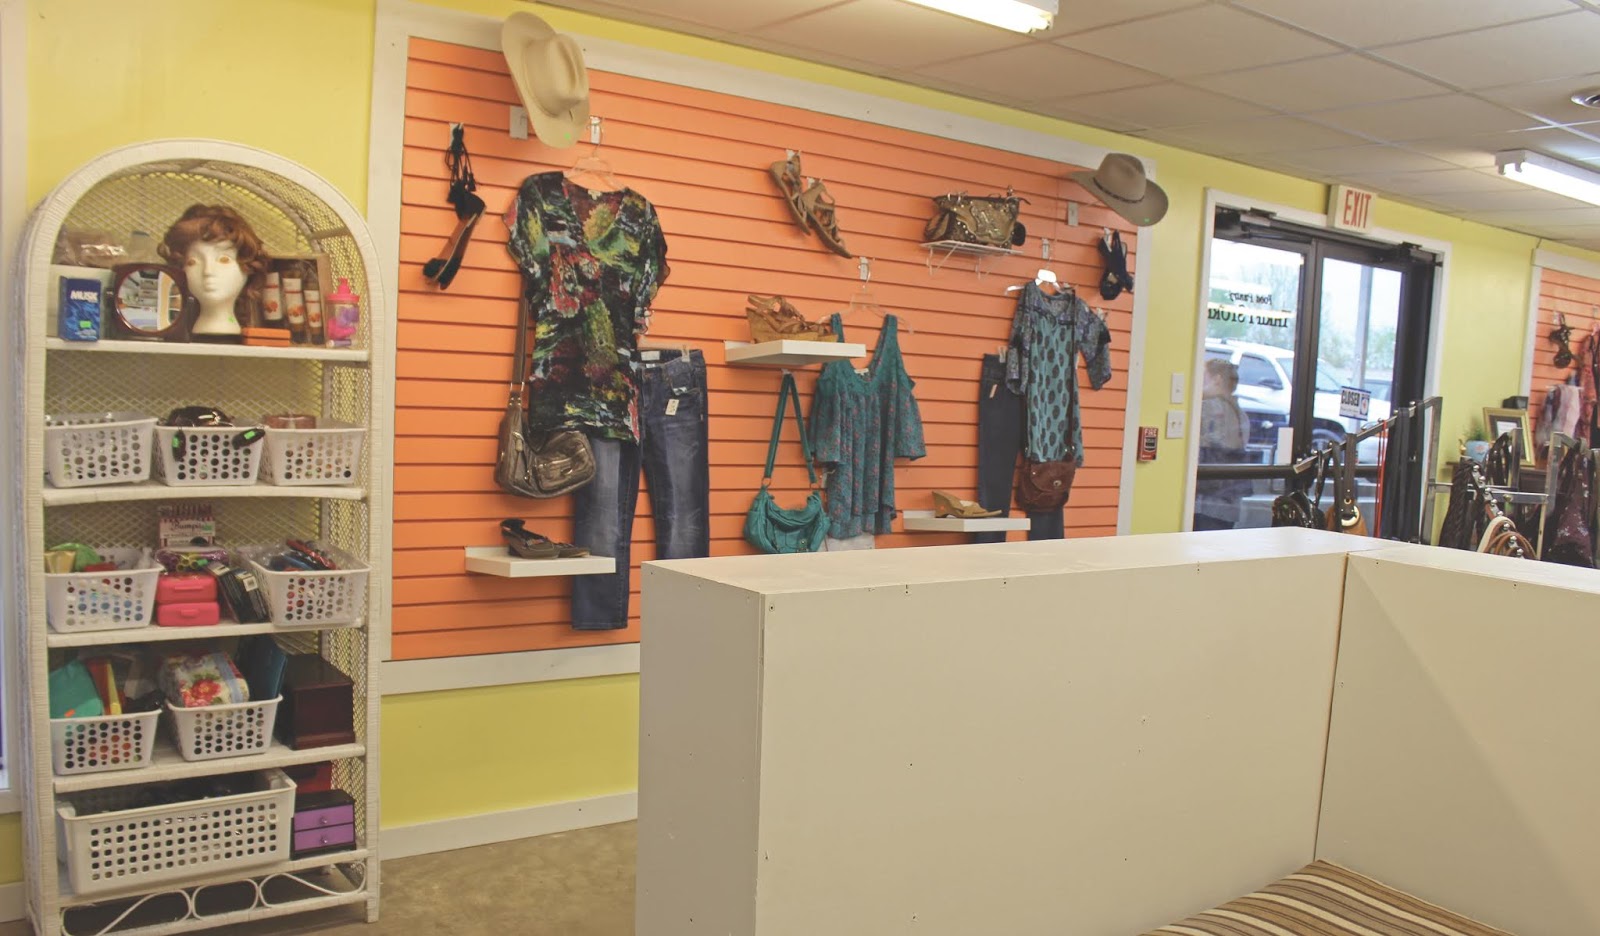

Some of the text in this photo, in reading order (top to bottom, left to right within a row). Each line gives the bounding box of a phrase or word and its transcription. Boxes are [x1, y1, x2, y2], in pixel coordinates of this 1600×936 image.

[1343, 189, 1372, 229] EXIT
[70, 290, 98, 303] MUSK
[1341, 389, 1360, 407] CLOSED
[1144, 428, 1157, 437] FIRE
